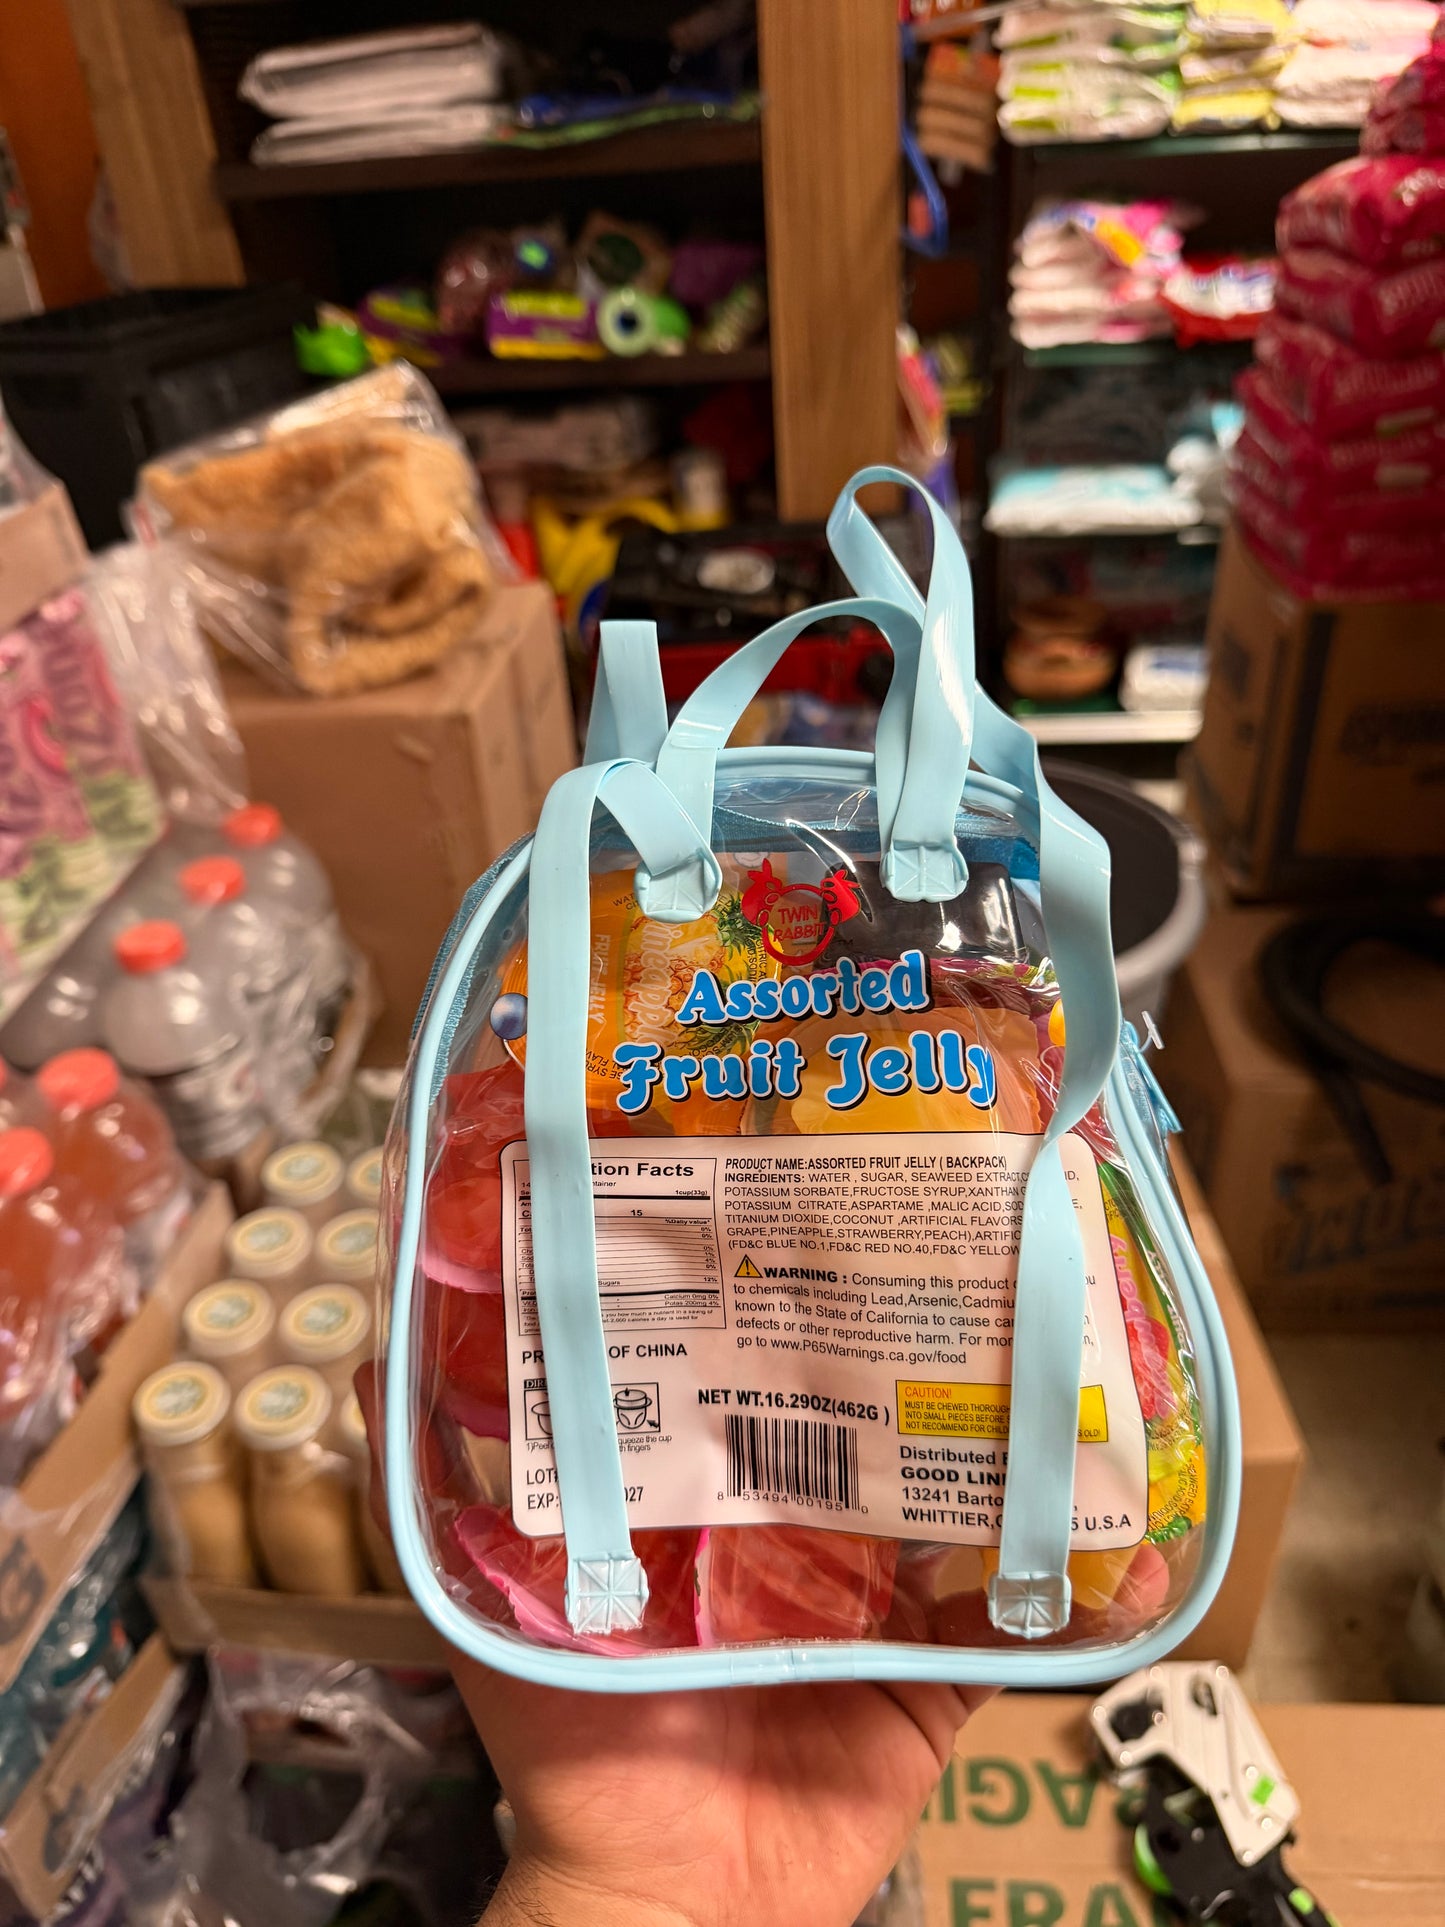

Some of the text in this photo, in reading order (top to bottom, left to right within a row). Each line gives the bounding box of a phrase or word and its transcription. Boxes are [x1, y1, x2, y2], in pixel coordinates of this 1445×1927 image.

[778, 904, 818, 924] TWIN
[773, 922, 825, 942] RABBIT
[675, 949, 933, 1027] Assorted
[613, 1029, 1000, 1117] Fruit Jelly
[637, 1163, 694, 1177] Facts
[725, 1158, 773, 1170] PRODUCT
[775, 1157, 867, 1170] NAME:ASSORTED
[869, 1156, 901, 1169] FRUIT
[903, 1156, 937, 1169] JELLY
[593, 1180, 617, 1188] ntainer
[724, 1172, 805, 1183] INGREDIENTS:
[860, 1172, 908, 1184] SUGAR,
[913, 1172, 973, 1182] SEAWEED
[724, 1187, 790, 1197] POTASSIUM
[793, 1186, 919, 1198] SORBATE,FRUCTOSE
[923, 1186, 1019, 1198] SYRUP,XANTHAN
[724, 1200, 792, 1211] POTASSIUM
[797, 1200, 924, 1212] CITRATE,ASPARTAME
[971, 1201, 1024, 1213] ACID,SOD
[725, 1214, 779, 1224] TITANIUM
[782, 1214, 894, 1226] DIOXIDE,COCONUT
[726, 1226, 1022, 1242] GRAPE,PINEAPPLE,STRAWBERRY,PEACH),ARTIFIC
[728, 1239, 1020, 1255] (FD&C BLUE NO.1,FD&C RED NO.40,FD&C YELLOW
[763, 1267, 838, 1283] WARNING
[852, 1272, 926, 1290] Consuming
[930, 1276, 954, 1289] this
[958, 1277, 1009, 1291] product
[734, 1283, 1015, 1310] to chemicals including Lead,Arsenic,Cadmiu
[735, 1300, 775, 1312] known
[779, 1302, 791, 1312] to
[794, 1302, 812, 1315] the
[815, 1305, 847, 1320] State
[850, 1310, 863, 1322] of
[866, 1310, 928, 1325] California
[932, 1314, 946, 1326] to
[949, 1316, 990, 1327] cause
[736, 1317, 1014, 1347] defects or other reproductive harm. For mor
[608, 1343, 688, 1359] OF CHINA
[736, 1336, 967, 1365] go to www.P65Warnings.ca.gov/food
[698, 1389, 732, 1405] NET
[904, 1386, 952, 1399] CAUTION!
[904, 1401, 926, 1410] MUST
[927, 1402, 936, 1410] BE
[937, 1402, 969, 1412] CHEWED
[905, 1411, 923, 1419] INTO
[924, 1411, 947, 1421] SMALL
[948, 1412, 974, 1422] PIECES
[975, 1414, 1006, 1423] BEFORE
[905, 1421, 920, 1429] NOT
[921, 1422, 969, 1432] RECOMMEND
[970, 1424, 986, 1433] FOR
[986, 1424, 1010, 1434] CHILD
[619, 1435, 672, 1445] queeze the cup
[628, 1443, 651, 1454] fingers
[899, 1445, 996, 1465] Distributed
[901, 1466, 959, 1483] GOOD
[717, 1491, 869, 1514] 8 53494 00195 0
[902, 1486, 1004, 1507] 13241 Barto
[1085, 1514, 1132, 1531] U.S.A
